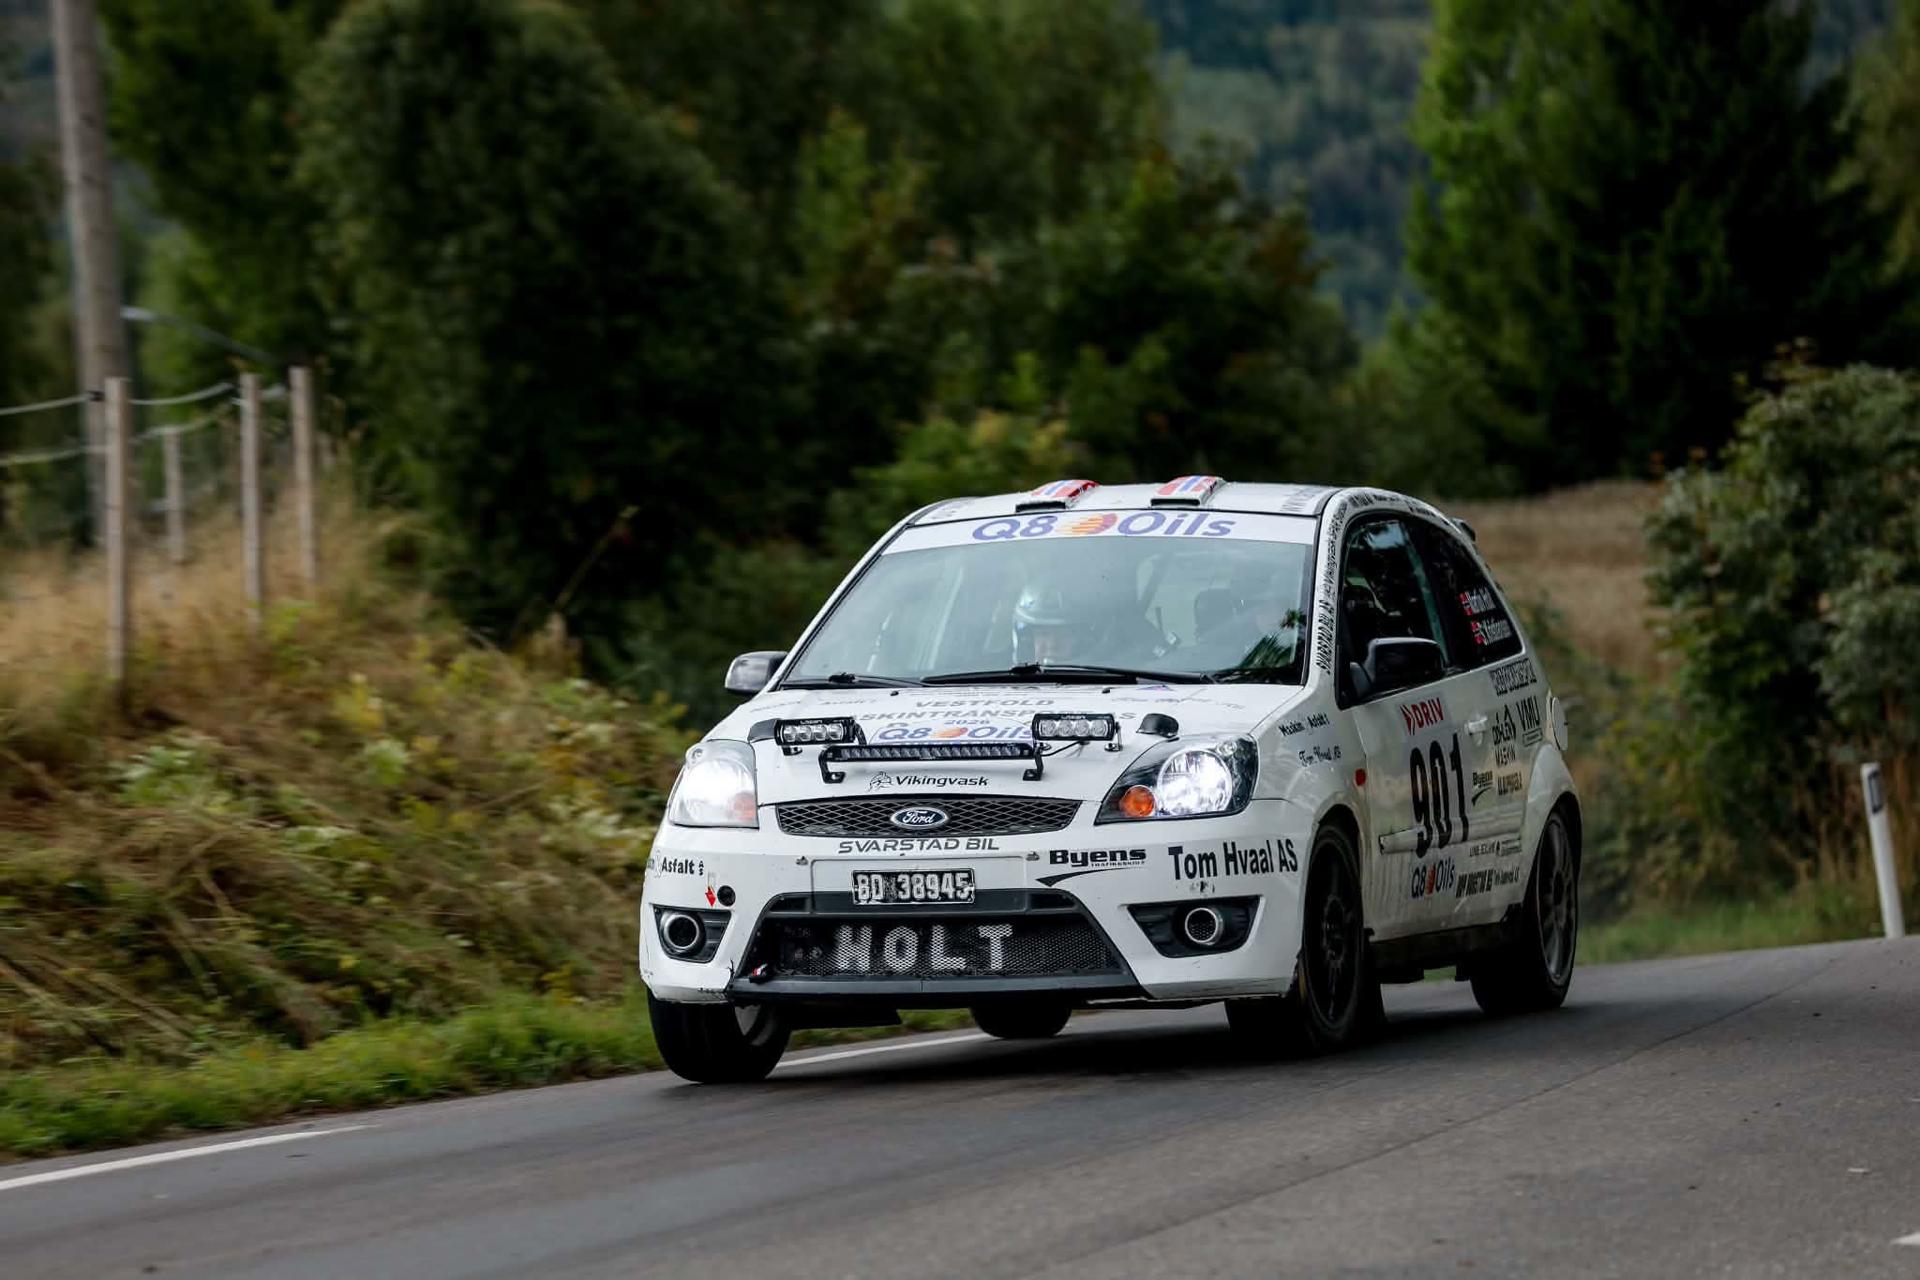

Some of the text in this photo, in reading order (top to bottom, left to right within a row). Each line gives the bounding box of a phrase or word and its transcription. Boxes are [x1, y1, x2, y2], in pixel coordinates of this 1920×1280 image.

[972, 512, 1236, 541] Q8 Oils
[916, 700, 1055, 708] VESTFOLD
[1412, 697, 1444, 729] DRIV
[1516, 695, 1540, 731] VMU
[879, 725, 1033, 740] Q8 Oils
[896, 776, 989, 788] Vikingvask
[1410, 732, 1469, 859] 901
[902, 811, 935, 825] Ford
[838, 838, 1000, 854] SVARSTAD BIL
[1050, 849, 1147, 868] Byens
[1168, 838, 1298, 881] Tom Hvaal AS
[661, 857, 695, 875] Asfalt
[1411, 866, 1427, 898] Q8
[1435, 858, 1455, 893] Oils
[897, 872, 972, 901] 38945
[835, 923, 1014, 973] HOLT
